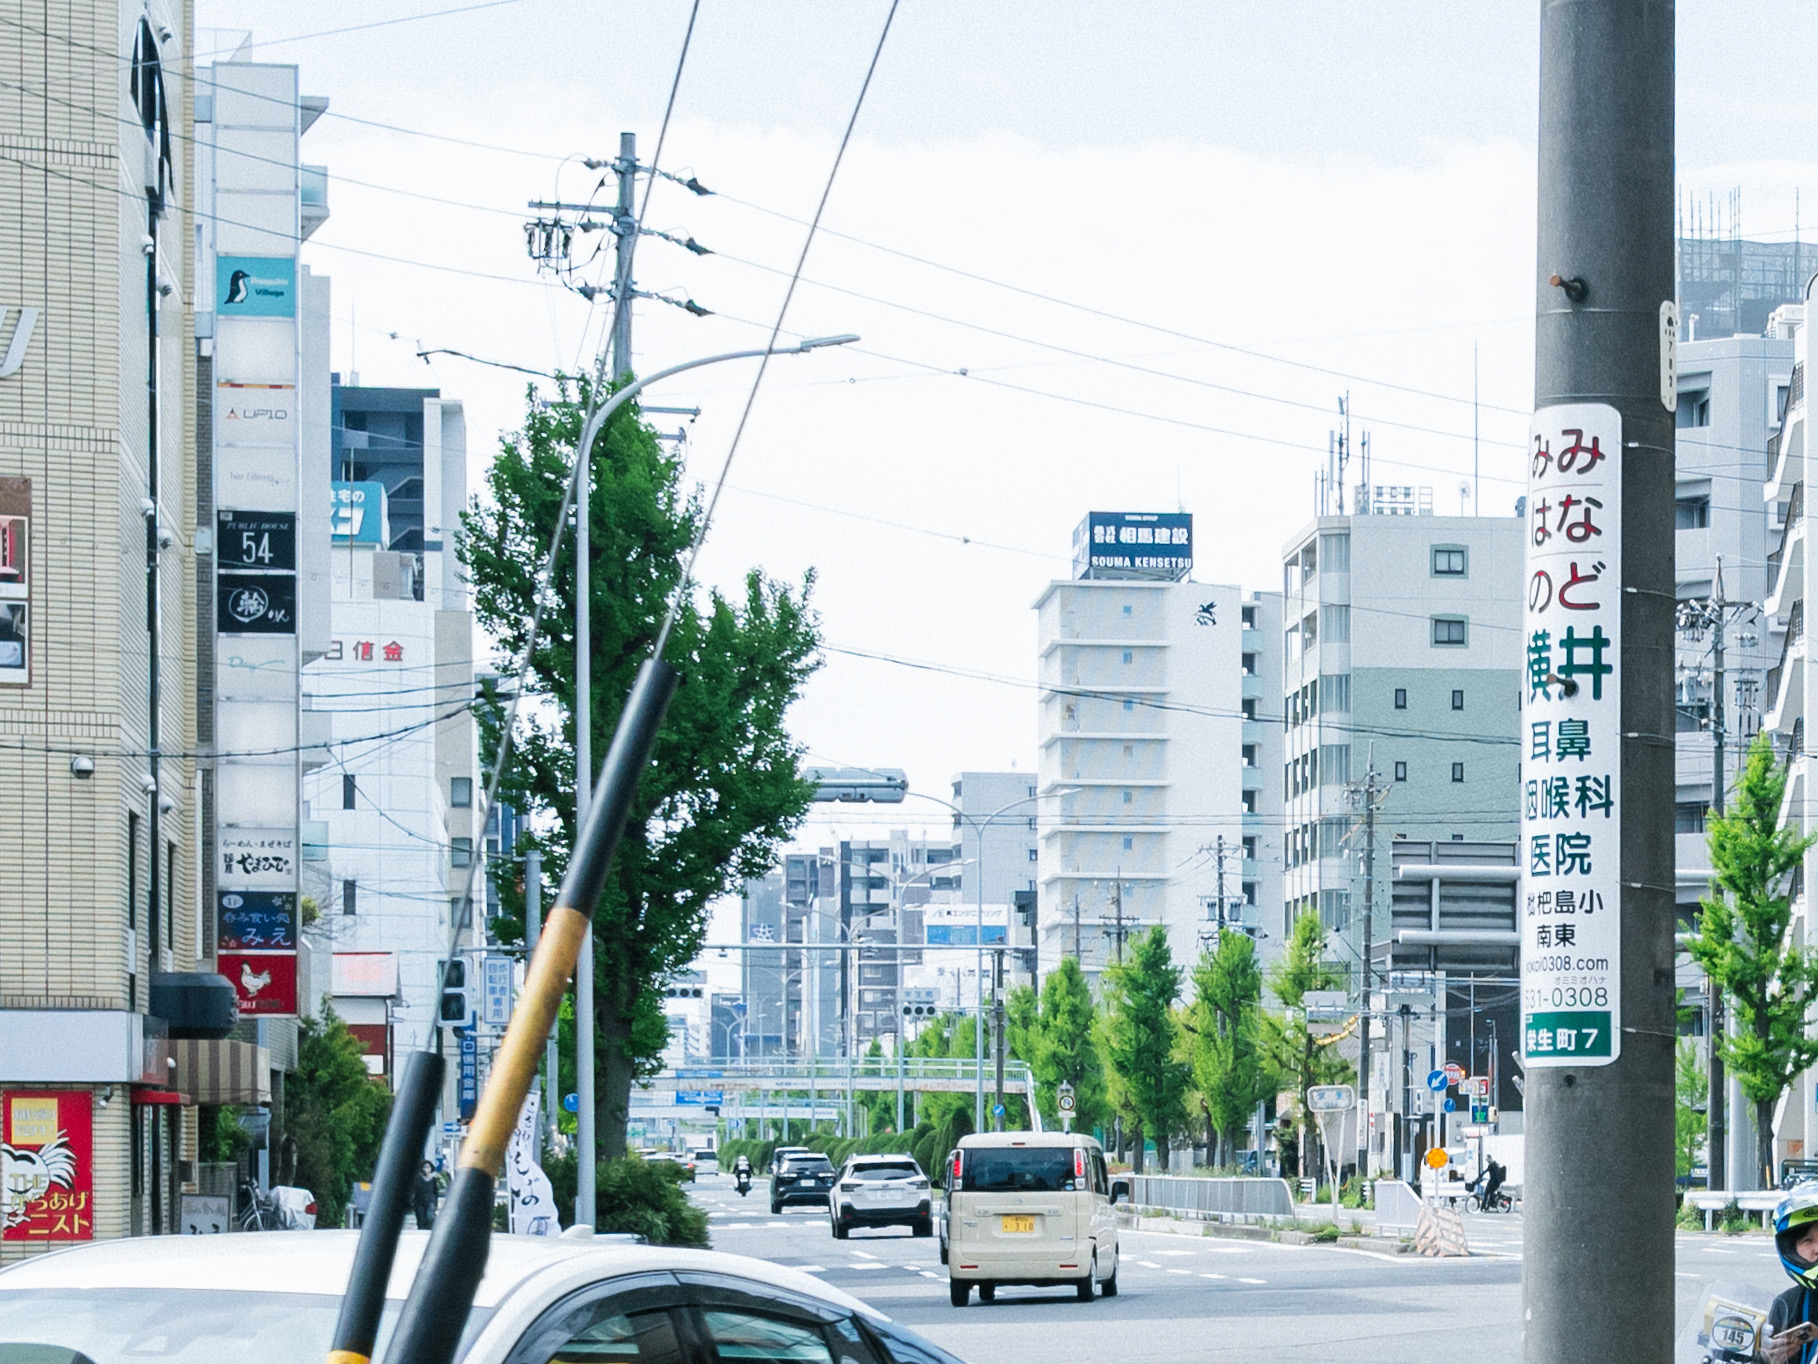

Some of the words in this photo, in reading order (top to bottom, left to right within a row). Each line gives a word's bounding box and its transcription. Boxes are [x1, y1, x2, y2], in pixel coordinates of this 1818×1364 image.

[1532, 428, 1606, 478] みみ
[1532, 494, 1603, 547] はな
[242, 532, 274, 564] 54
[1092, 556, 1131, 567] SOUMA
[1135, 557, 1192, 568] KENSETSU
[1529, 561, 1606, 613] のど
[1527, 625, 1613, 705] 横井
[1531, 718, 1592, 762] 耳鼻
[1525, 775, 1613, 820] 咽喉科
[236, 853, 289, 875] やまひで
[1531, 832, 1592, 877] 医院
[241, 927, 291, 946] みえ
[1537, 923, 1576, 948] 南東
[9, 1173, 48, 1190] THE
[28, 1213, 90, 1235] ニスト
[1722, 1328, 1745, 1345] 145
